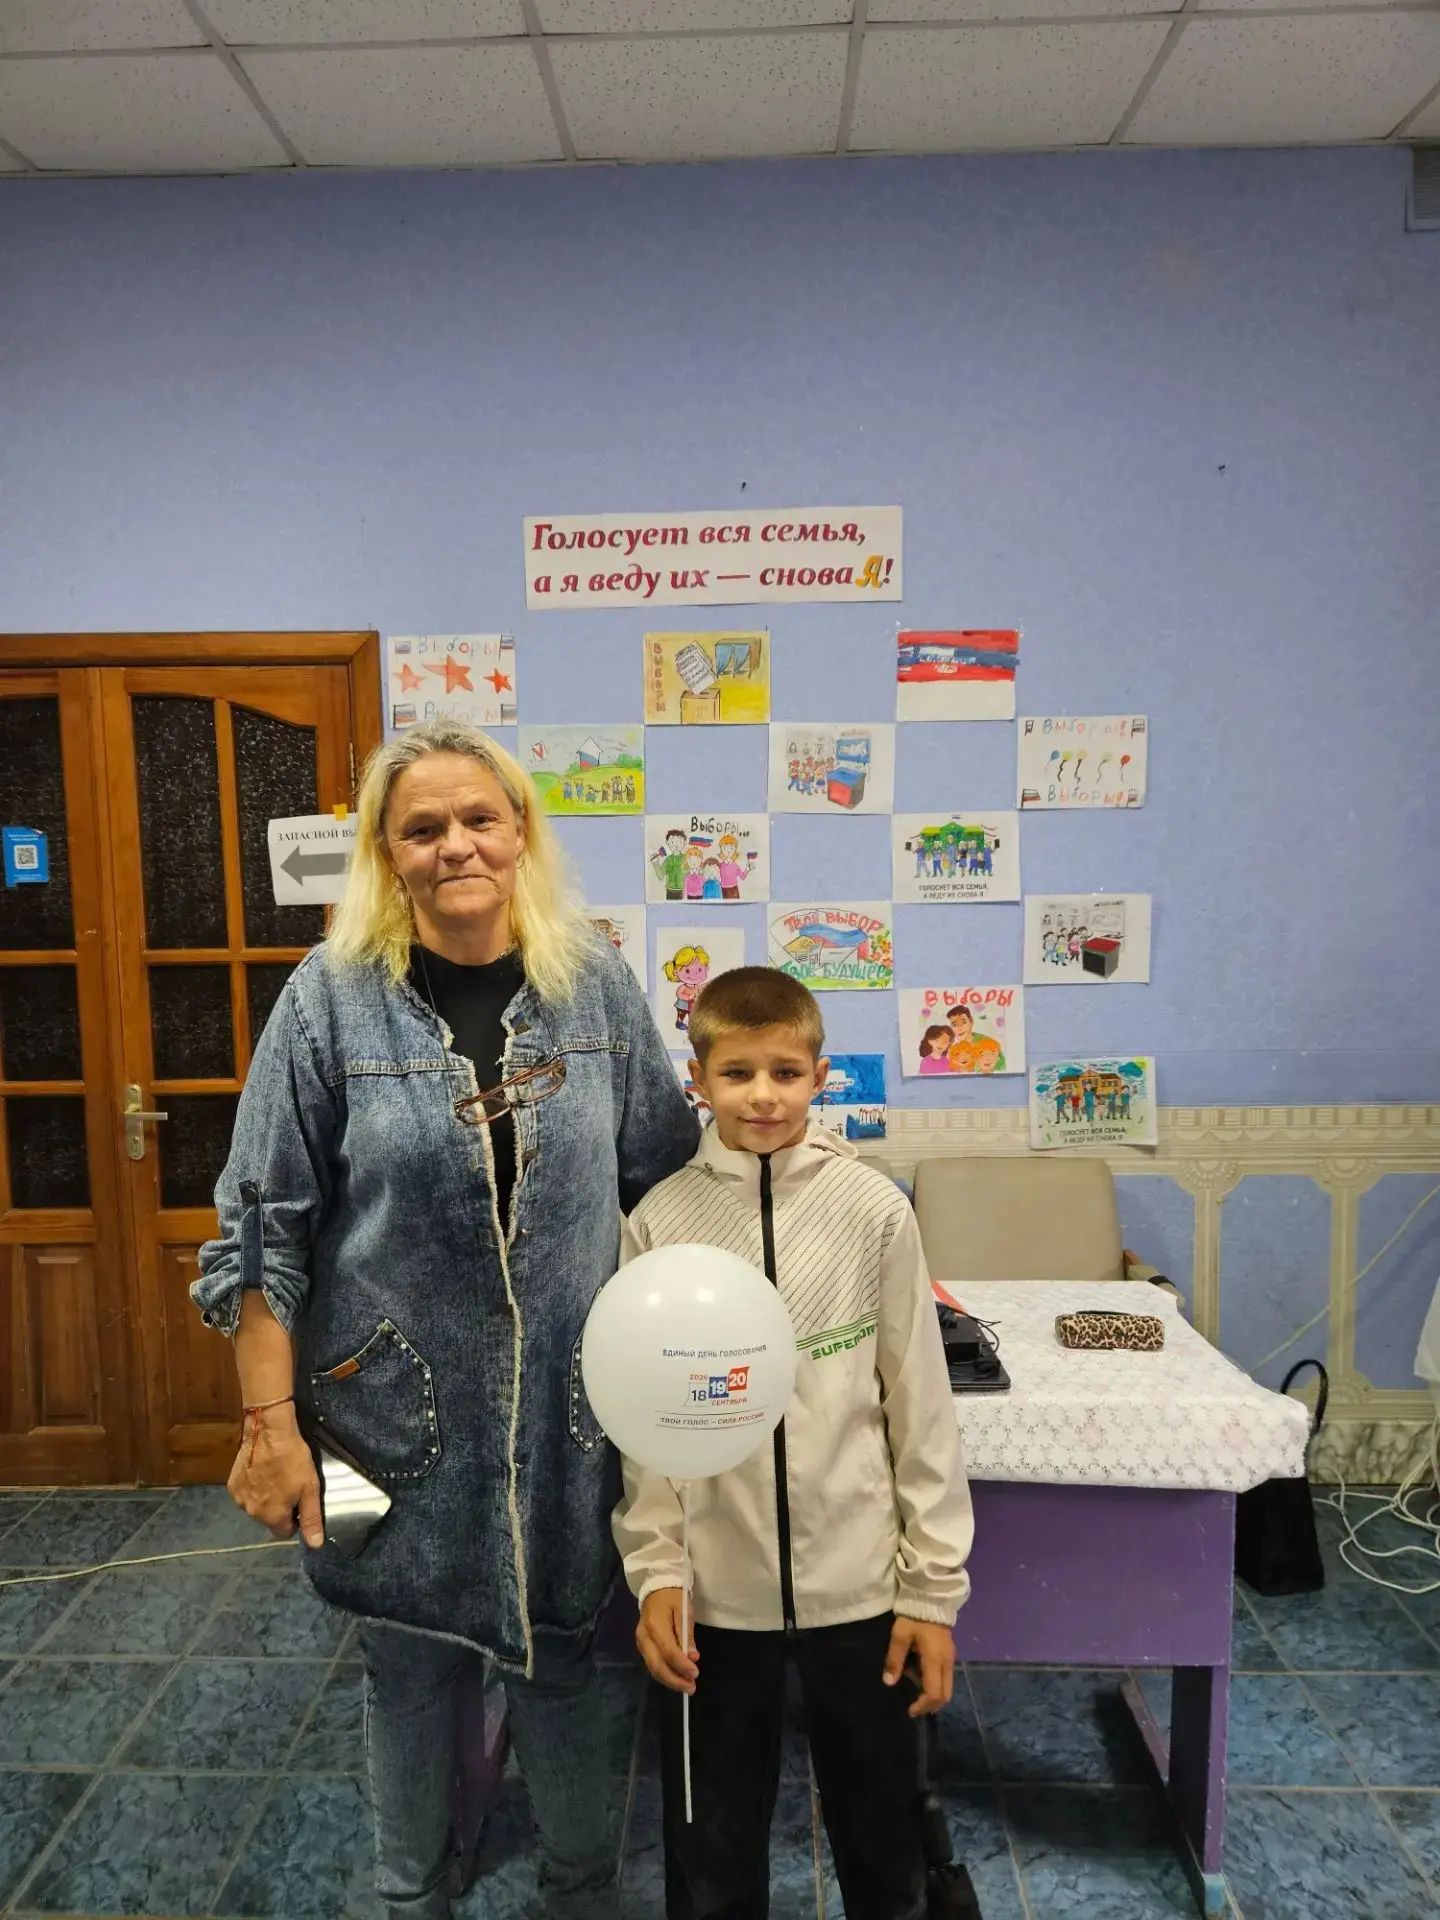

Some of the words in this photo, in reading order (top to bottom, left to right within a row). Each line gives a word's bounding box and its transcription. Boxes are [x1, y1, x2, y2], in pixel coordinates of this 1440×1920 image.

[531, 523, 689, 556] Голосует
[699, 524, 751, 545] вся
[760, 522, 866, 546] семья,
[534, 574, 552, 593] а
[560, 573, 580, 593] я
[588, 563, 661, 598] веду
[669, 568, 709, 589] их
[759, 565, 853, 586] снова
[276, 828, 339, 841] ЗАПАСНОЙ
[919, 884, 951, 892] ГОЛОСУЕТ
[952, 883, 965, 891] ВСЯ
[662, 1348, 696, 1358] ЕДИНЫЙ
[697, 1350, 718, 1359] ДЕНЬ
[719, 1344, 767, 1358] ГОЛОСОВАНИЯ
[691, 1389, 707, 1402] 18
[710, 1380, 727, 1395] 19
[728, 1372, 747, 1388] 20
[711, 1397, 747, 1406] СЕНТЯБРЯ
[660, 1416, 682, 1425] ТВОЙ
[682, 1418, 709, 1426] ГОЛОС
[717, 1417, 737, 1425] СИЛА
